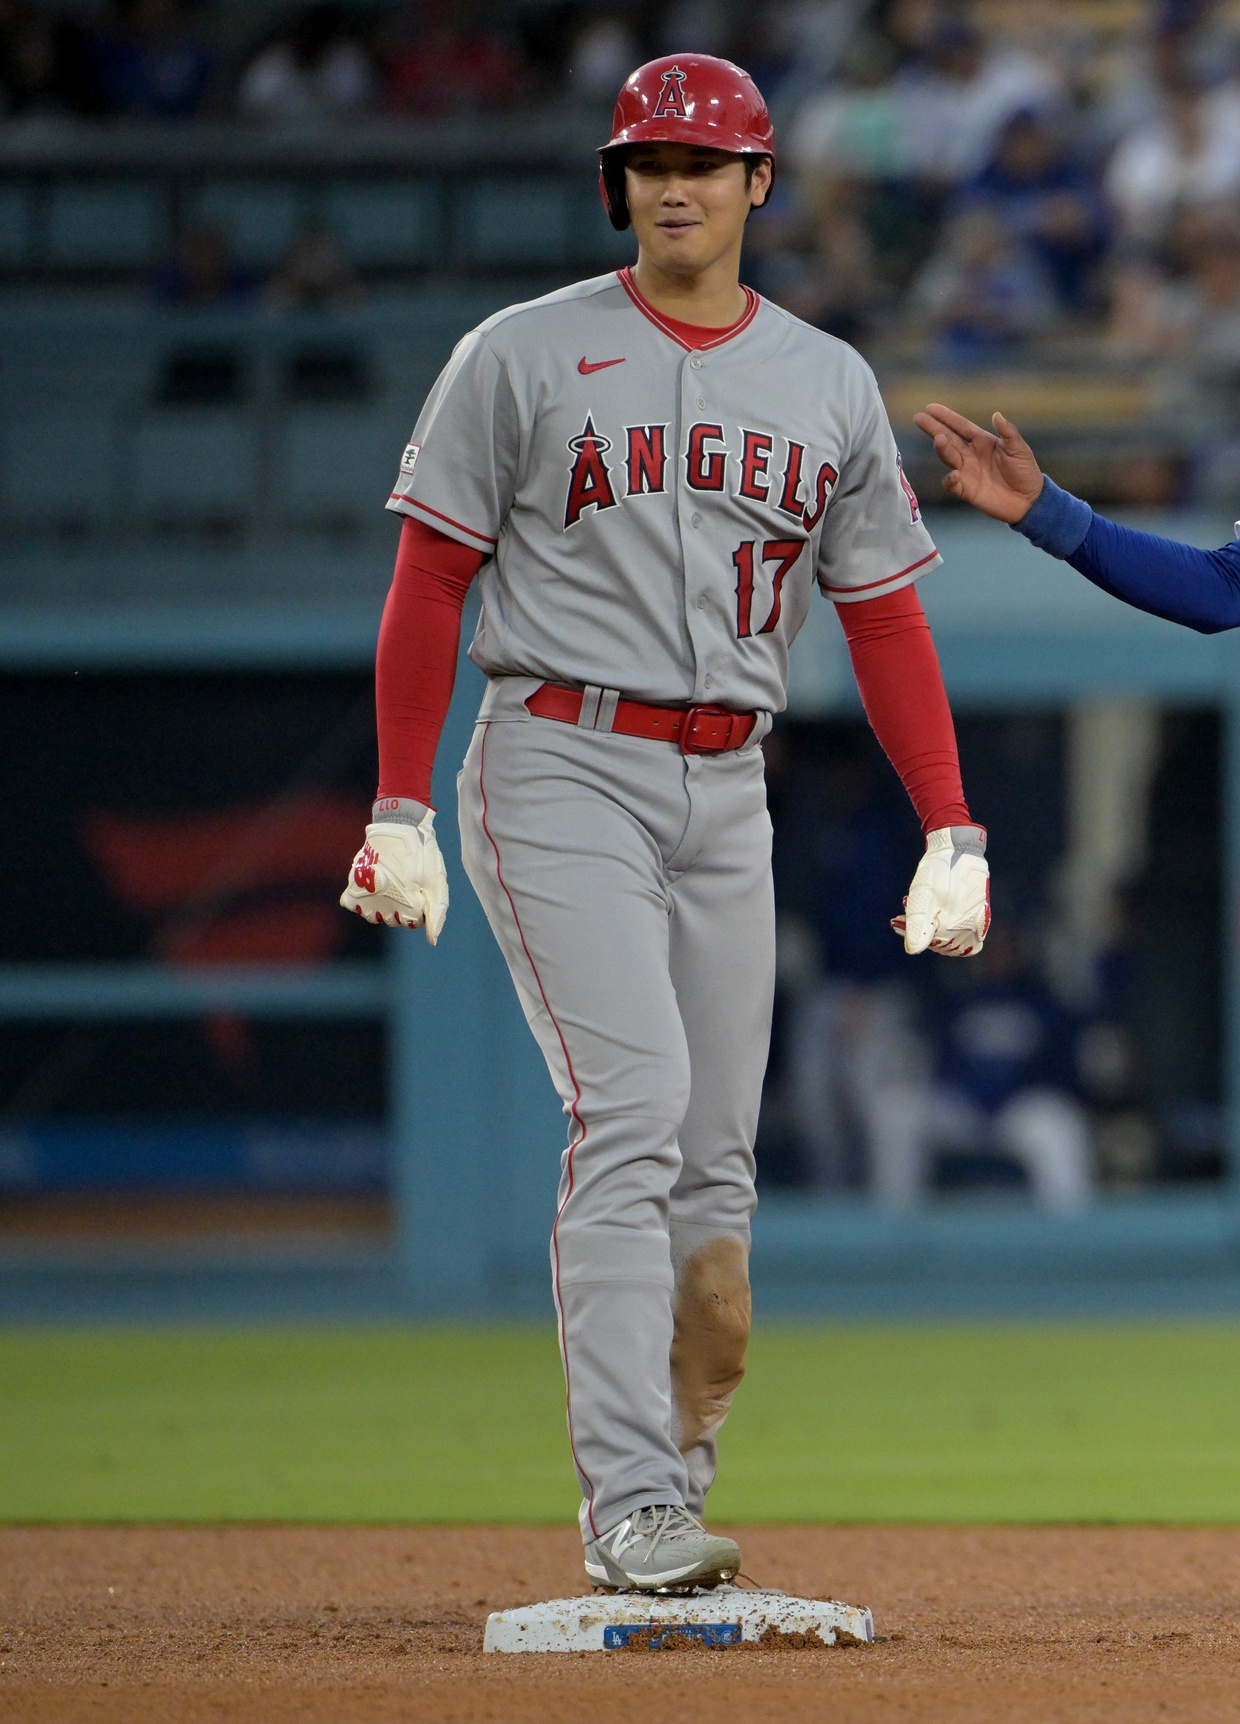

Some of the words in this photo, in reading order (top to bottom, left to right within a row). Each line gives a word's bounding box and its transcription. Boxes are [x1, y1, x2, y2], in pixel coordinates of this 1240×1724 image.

[652, 65, 691, 118] A
[562, 408, 840, 535] ANGELS
[732, 538, 807, 640] 17
